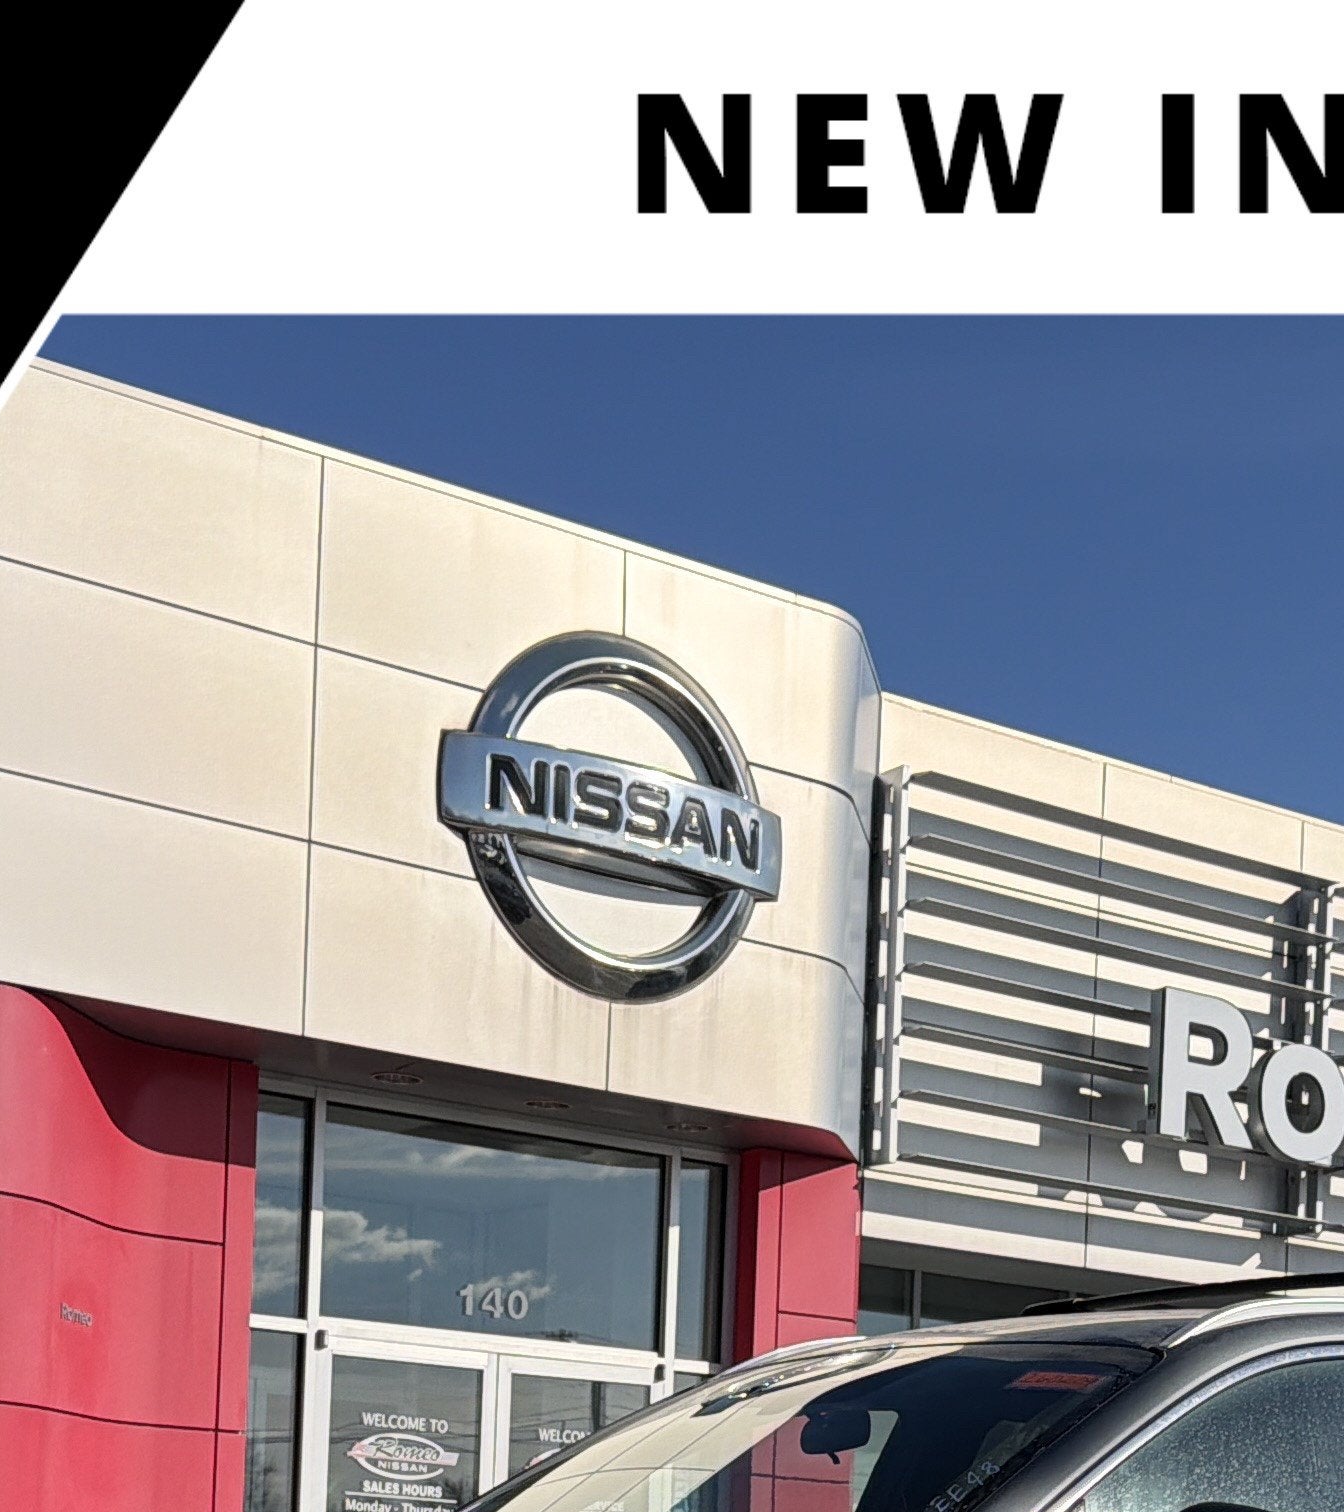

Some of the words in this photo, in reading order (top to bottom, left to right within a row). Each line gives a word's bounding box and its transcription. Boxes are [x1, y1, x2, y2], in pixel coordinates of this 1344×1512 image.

[486, 752, 763, 873] NISSAN
[458, 1283, 529, 1320] 140
[362, 1412, 426, 1431] WELCOME
[429, 1418, 449, 1434] TO
[377, 1460, 428, 1474] NISSAN
[362, 1479, 400, 1495] SALES
[402, 1483, 443, 1498] HOURS
